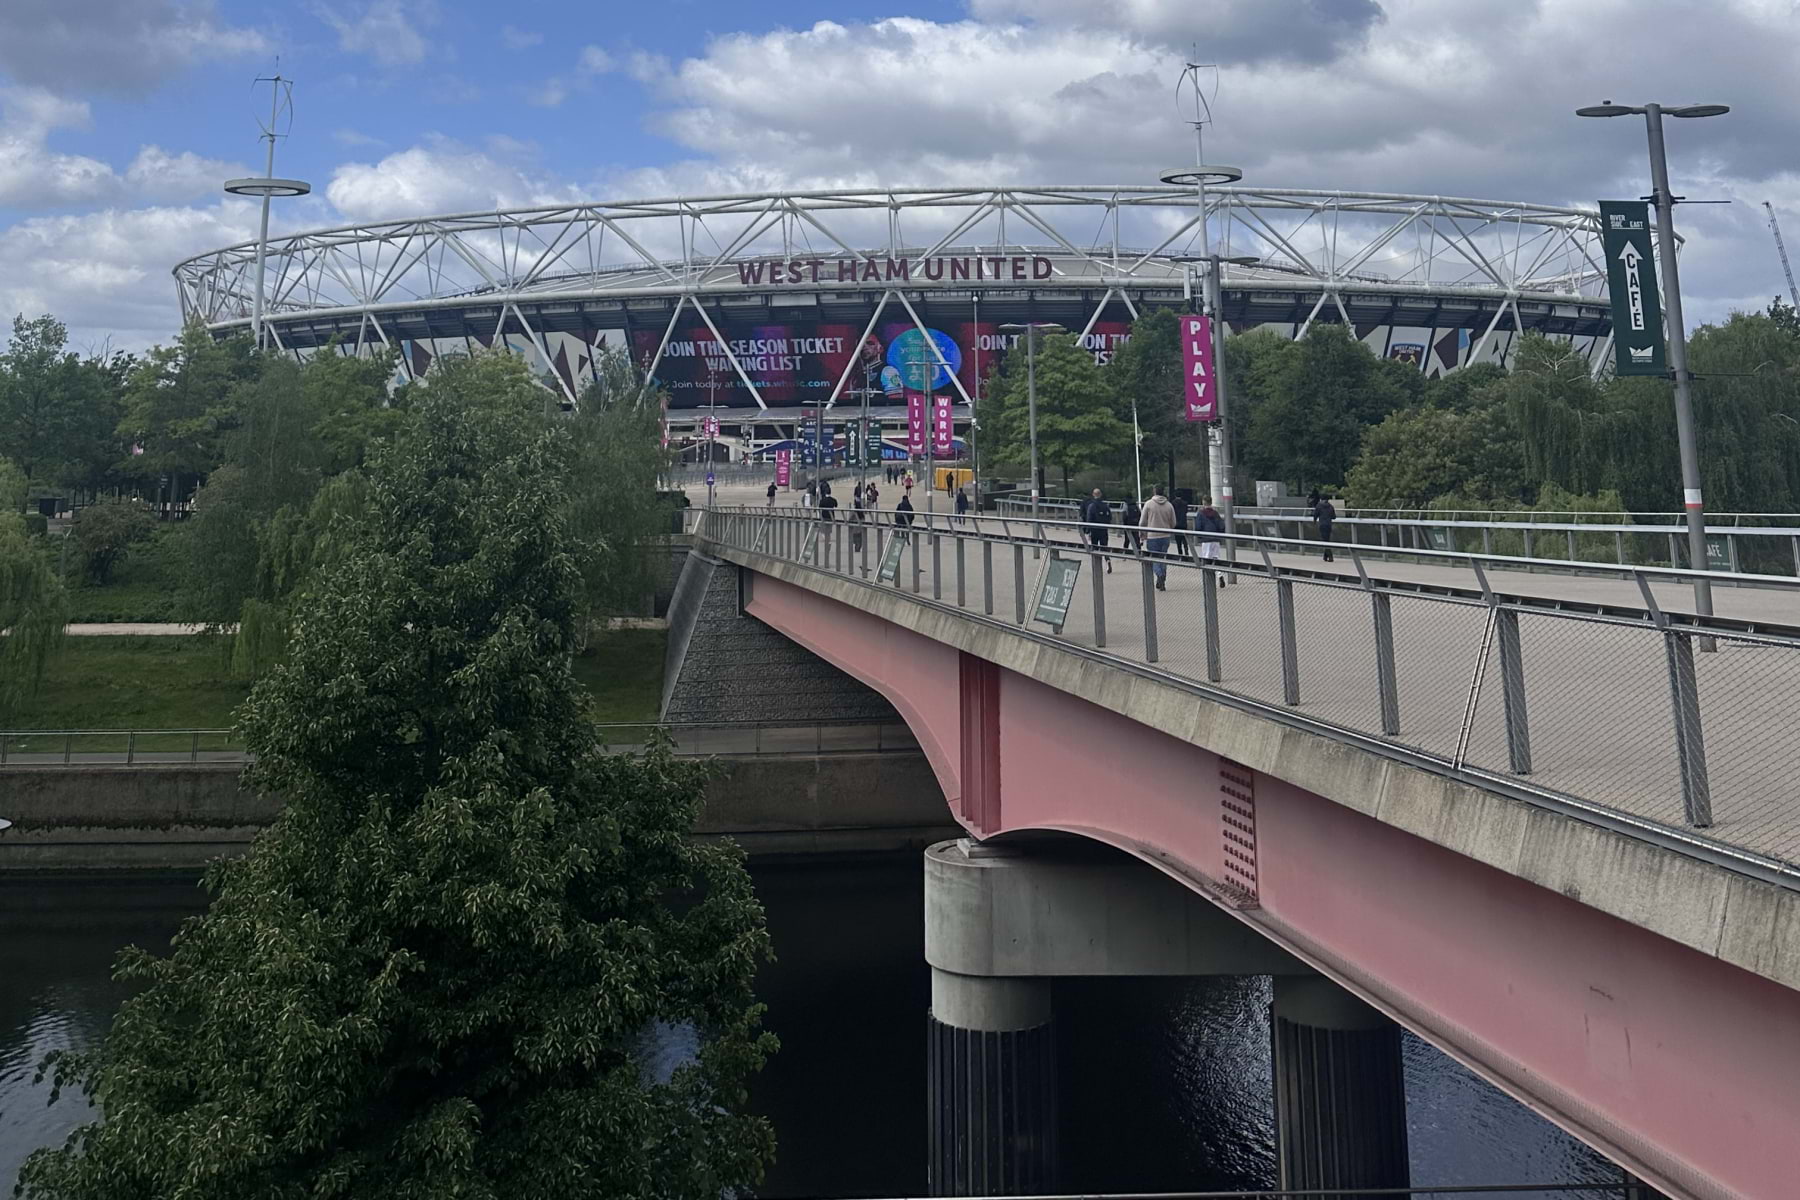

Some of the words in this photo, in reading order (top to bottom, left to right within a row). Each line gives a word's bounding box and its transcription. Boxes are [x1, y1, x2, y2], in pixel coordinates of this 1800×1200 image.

[738, 260, 824, 284] WEST
[838, 256, 909, 282] HAM
[924, 255, 1053, 281] UNITED
[1626, 253, 1642, 327] CAFÉ
[664, 341, 696, 357] JOIN
[729, 339, 788, 355] SEASON
[791, 337, 843, 354] TICKET
[971, 335, 1006, 350] JOIN
[770, 356, 802, 371] LIST
[1190, 321, 1206, 397] PLAY
[695, 381, 721, 390] today
[938, 398, 948, 441] WORK
